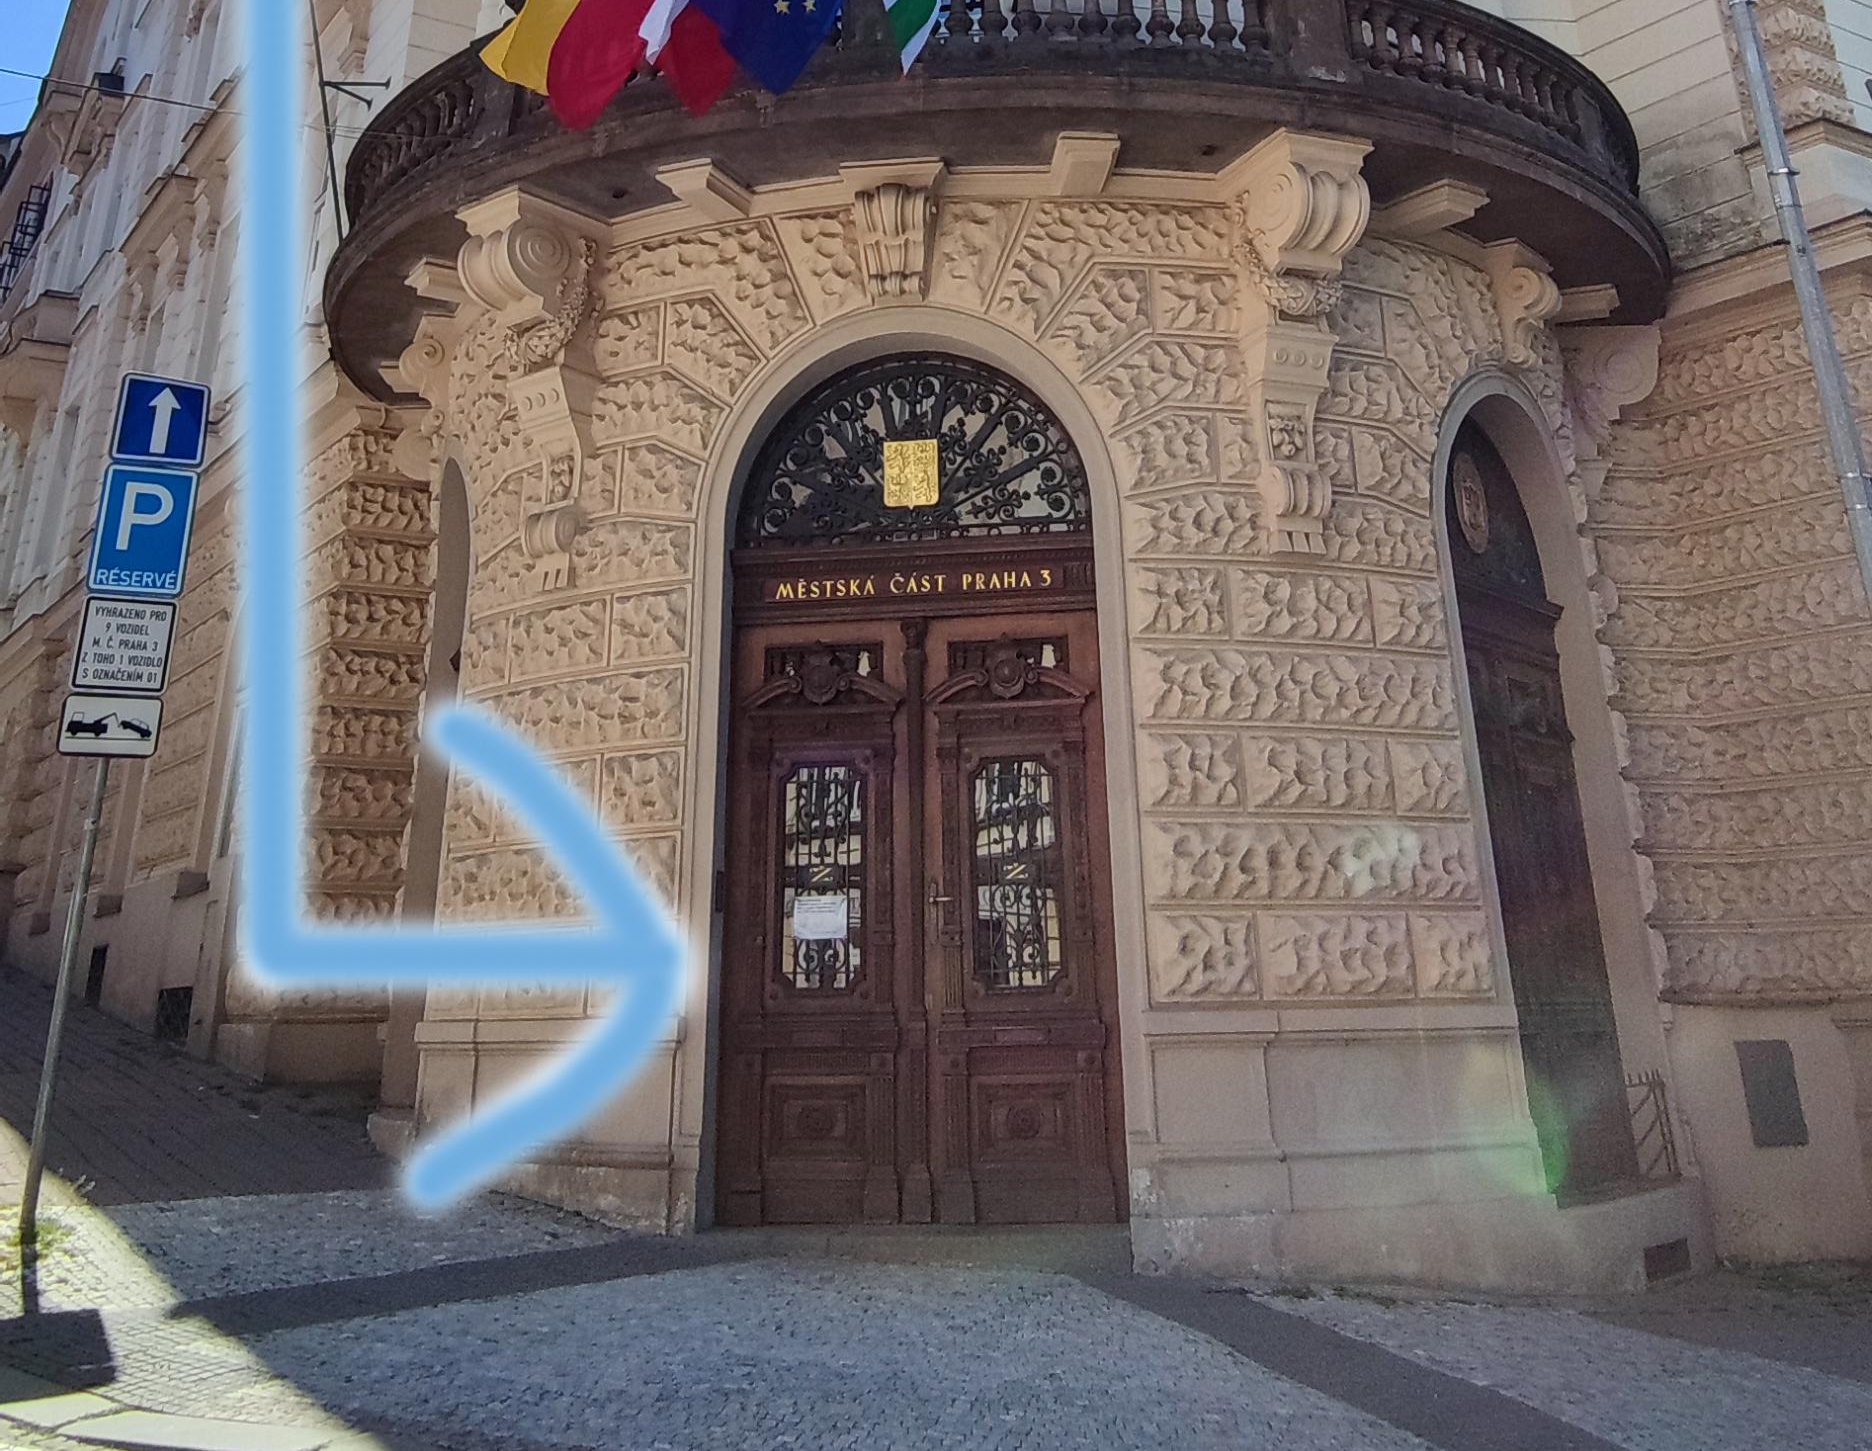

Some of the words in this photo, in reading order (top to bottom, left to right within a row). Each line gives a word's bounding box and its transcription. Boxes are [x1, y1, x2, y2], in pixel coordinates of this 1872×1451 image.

[116, 480, 174, 550] P
[96, 566, 177, 589] RÉSERVÉ
[775, 575, 875, 600] MĚSTSKÁ
[890, 571, 946, 594] ČÁST
[962, 571, 1032, 591] PRAHA
[1039, 569, 1051, 587] 3
[95, 606, 147, 621] VYHRAZENO
[149, 610, 167, 622] PRO
[105, 622, 112, 633] 9
[116, 623, 150, 636] VOZIDEL
[118, 639, 147, 651] PRAHA
[152, 641, 158, 652] 3
[81, 652, 88, 663] Z
[93, 652, 115, 664] TOHO
[128, 654, 163, 668] VOZIDLO
[82, 668, 89, 679] S
[92, 667, 144, 683] OZNAČENÍM
